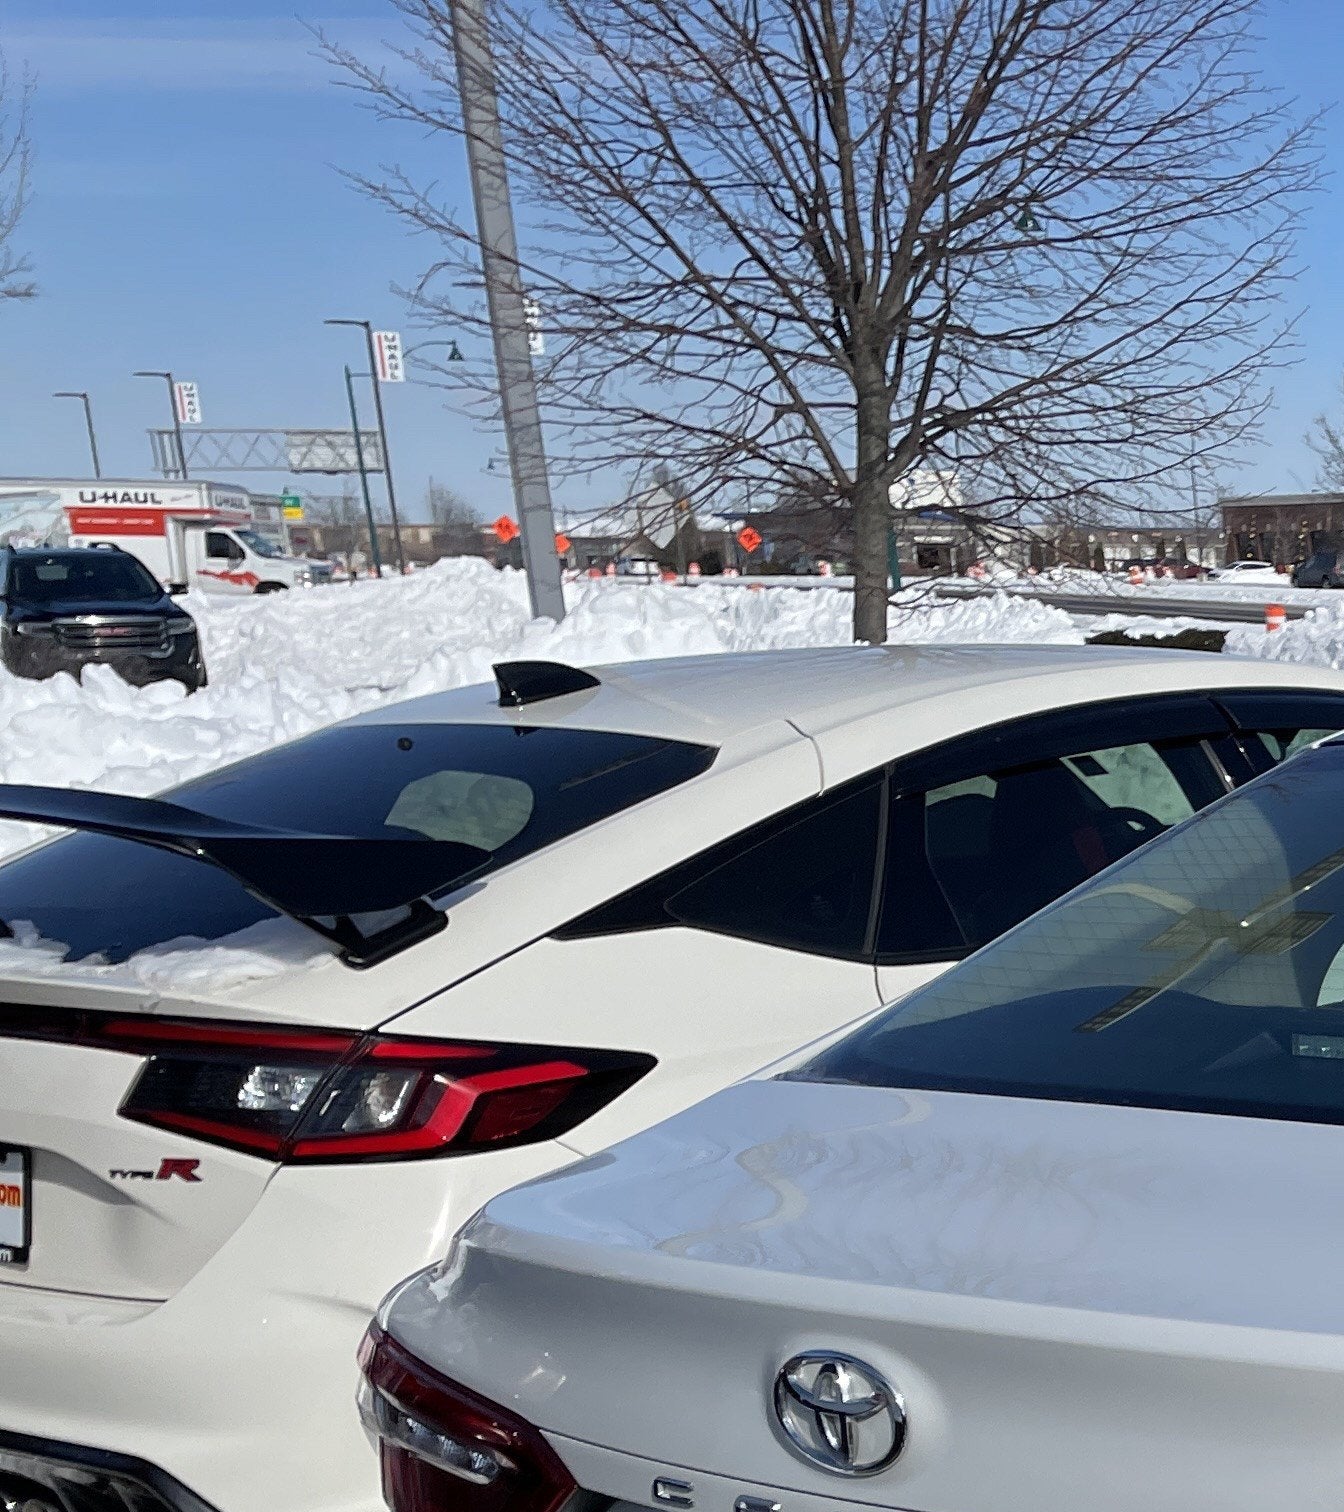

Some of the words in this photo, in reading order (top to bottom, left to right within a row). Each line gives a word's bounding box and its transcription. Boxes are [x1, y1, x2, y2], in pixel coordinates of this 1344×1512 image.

[78, 490, 163, 505] U-HAUL
[109, 1169, 154, 1179] TYPE
[155, 1158, 203, 1182] R
